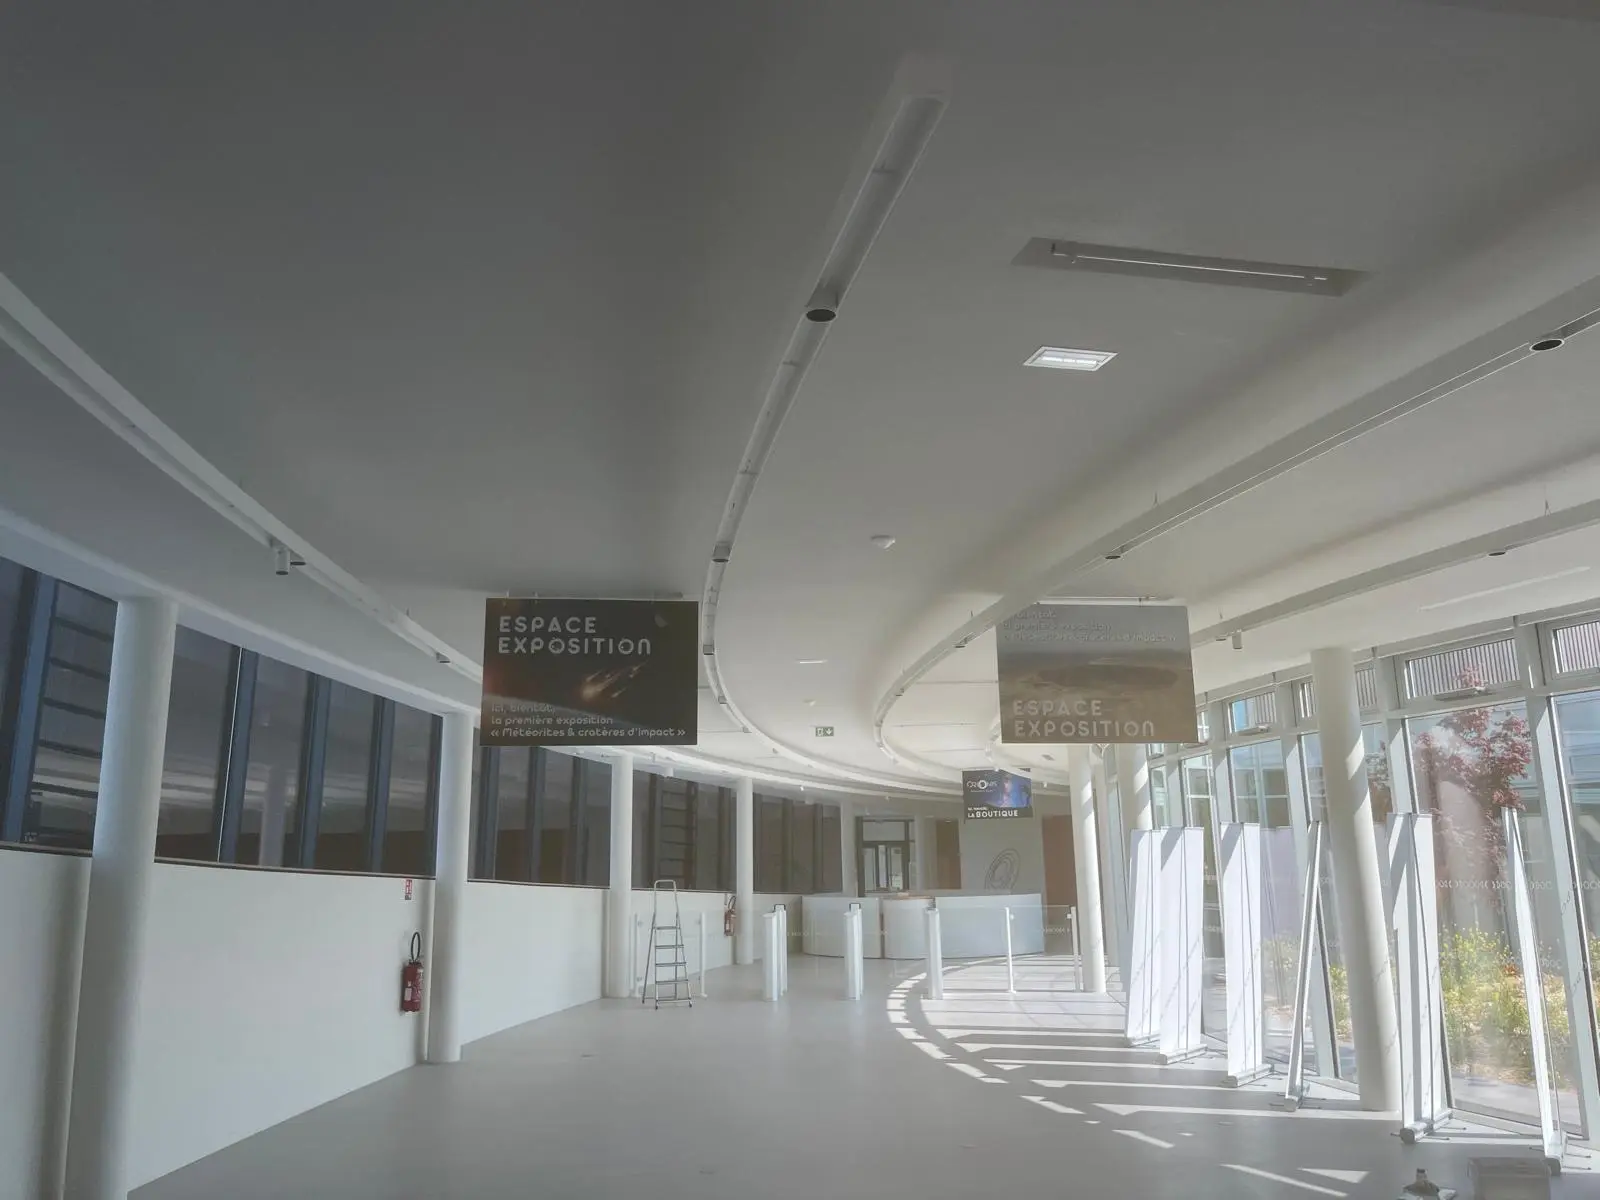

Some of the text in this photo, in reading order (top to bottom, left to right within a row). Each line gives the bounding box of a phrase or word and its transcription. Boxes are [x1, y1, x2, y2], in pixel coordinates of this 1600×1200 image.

[499, 616, 597, 633] ESPACE
[498, 637, 651, 655] EXPOSITION
[1013, 700, 1102, 716] ESPACE
[491, 716, 613, 727] la première exposition
[1014, 720, 1155, 737] EXPOSITION
[502, 728, 565, 737] Météorites
[567, 728, 575, 737] &
[578, 727, 625, 737] cratères
[627, 728, 675, 739] d'impact
[975, 809, 1018, 818] BOUTIQUE
